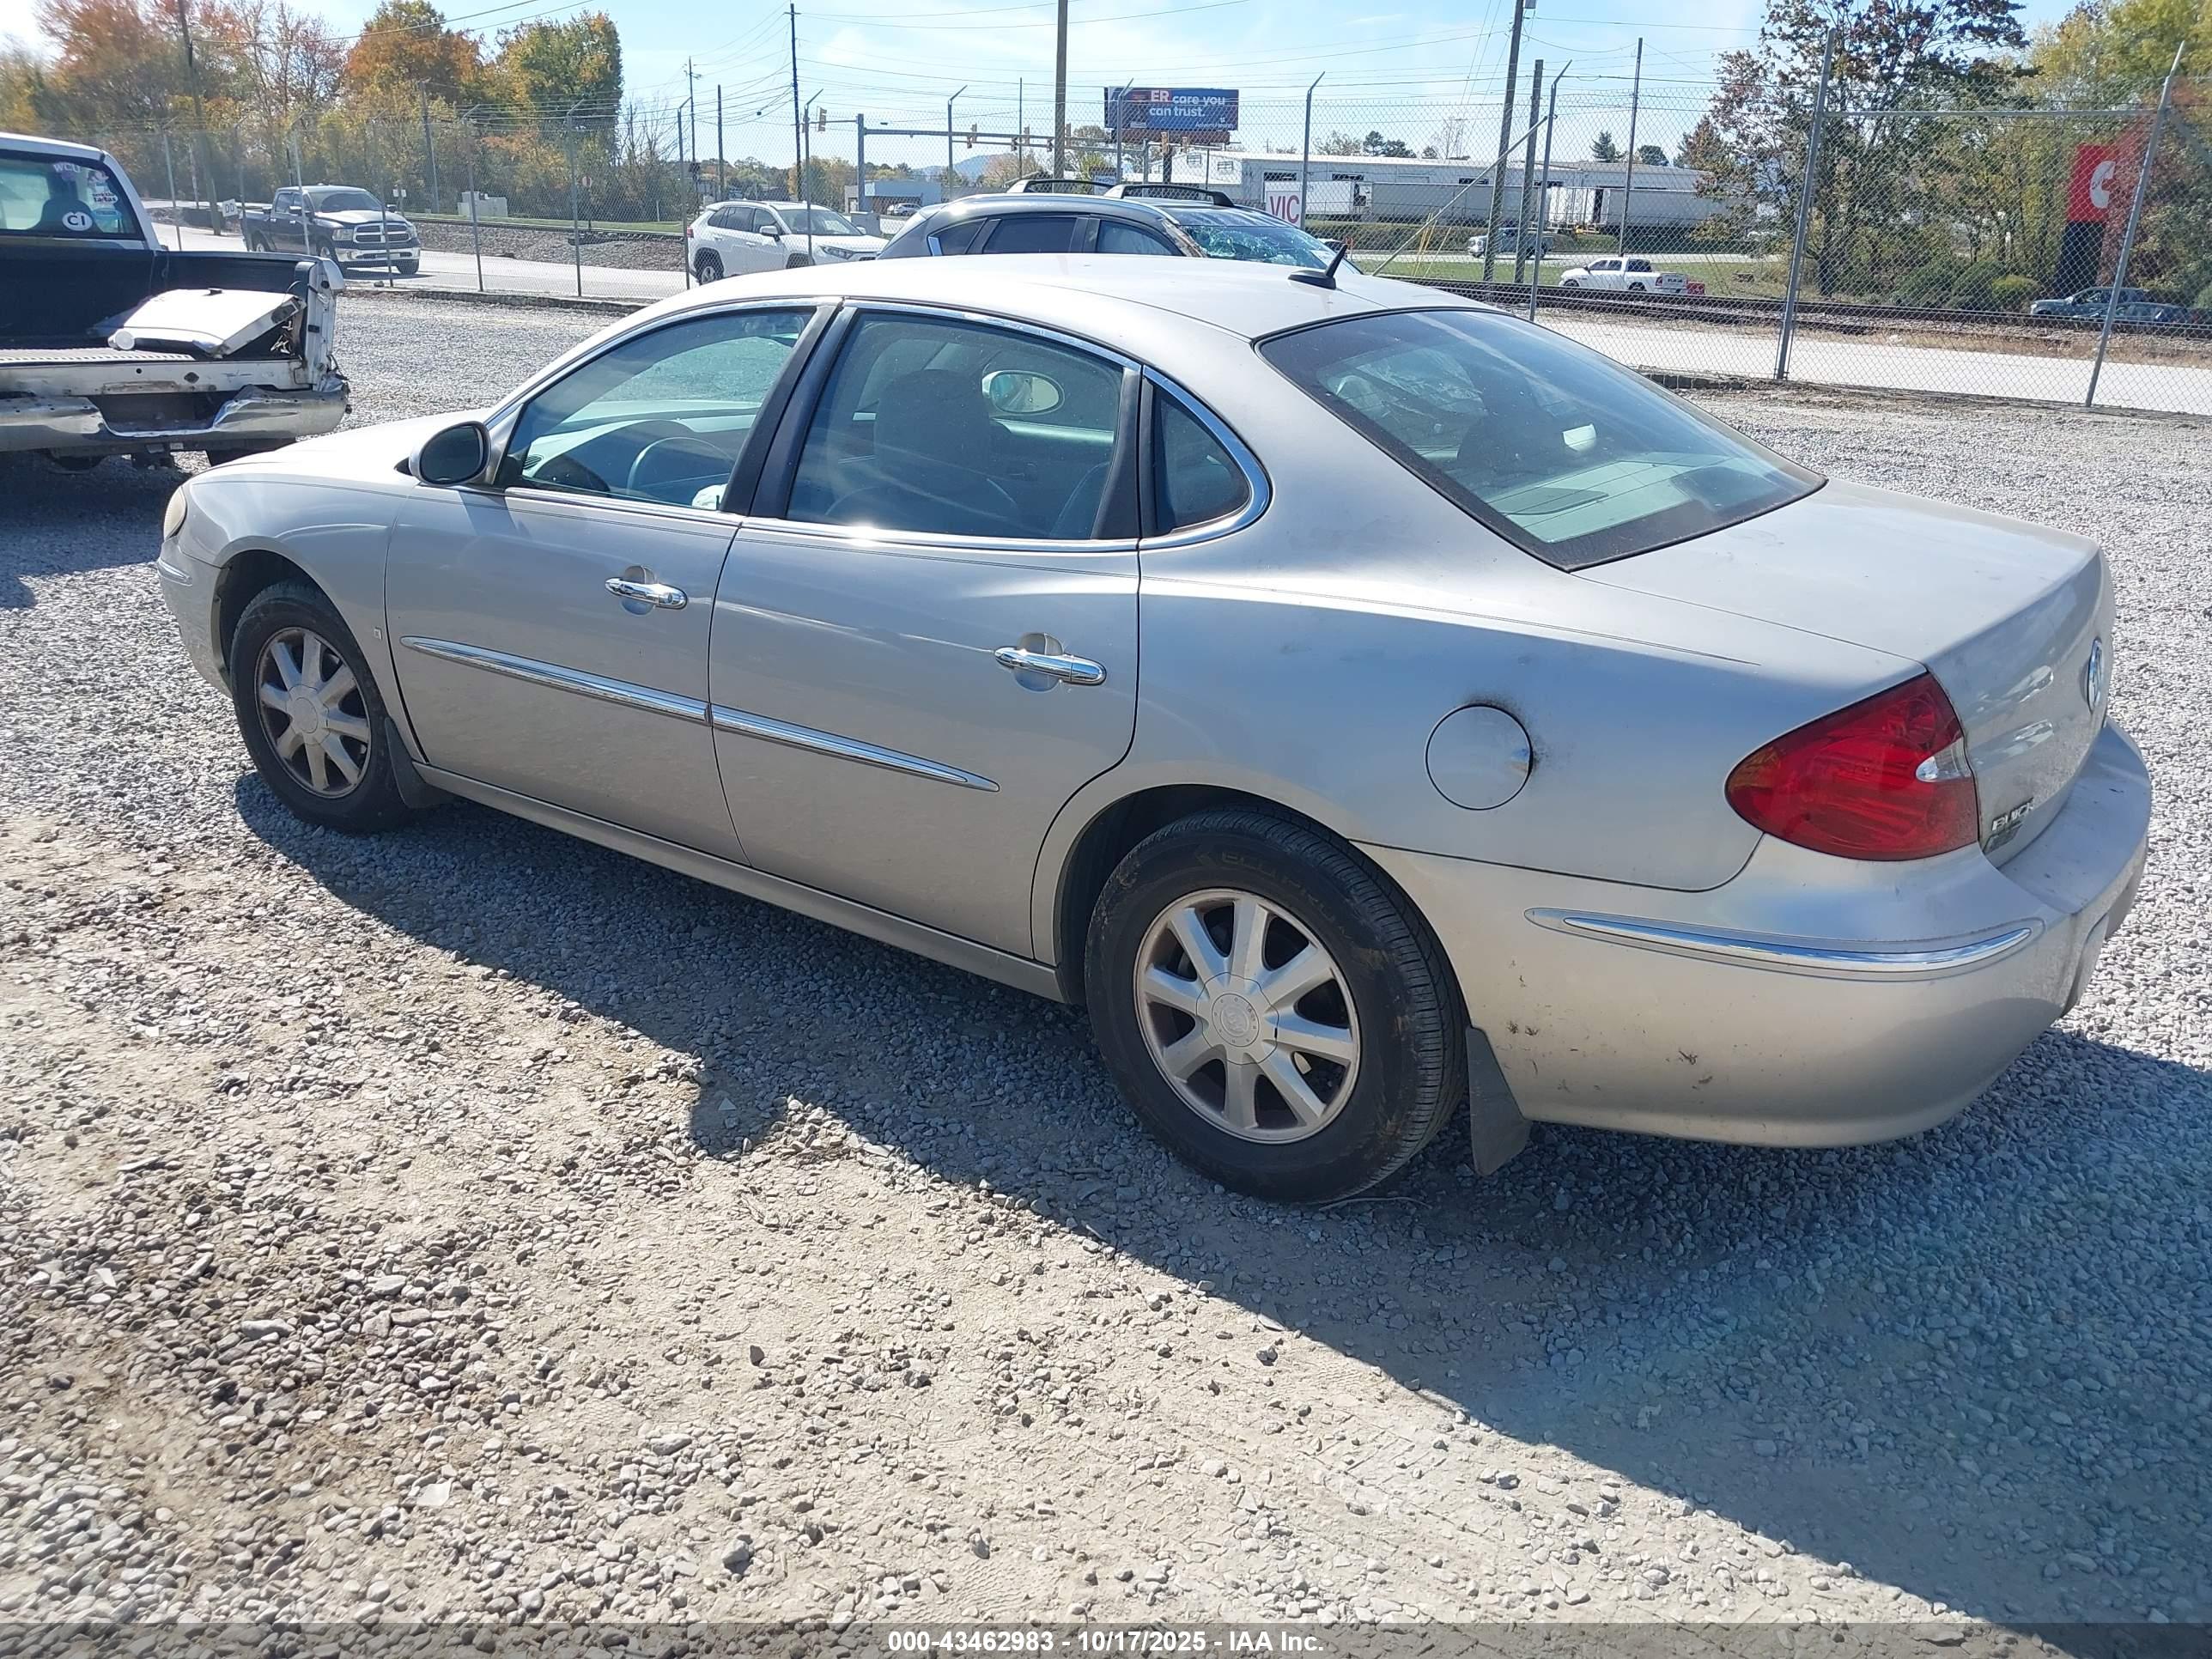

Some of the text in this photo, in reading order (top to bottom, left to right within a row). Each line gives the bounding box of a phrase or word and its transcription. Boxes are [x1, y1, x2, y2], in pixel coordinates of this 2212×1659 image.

[1151, 89, 1170, 102] ER
[1172, 94, 1200, 104] care
[1203, 96, 1225, 106] you
[1149, 106, 1206, 117] can trust.
[53, 162, 81, 172] WCU
[1270, 195, 1300, 223] VIC
[67, 215, 86, 226] CI
